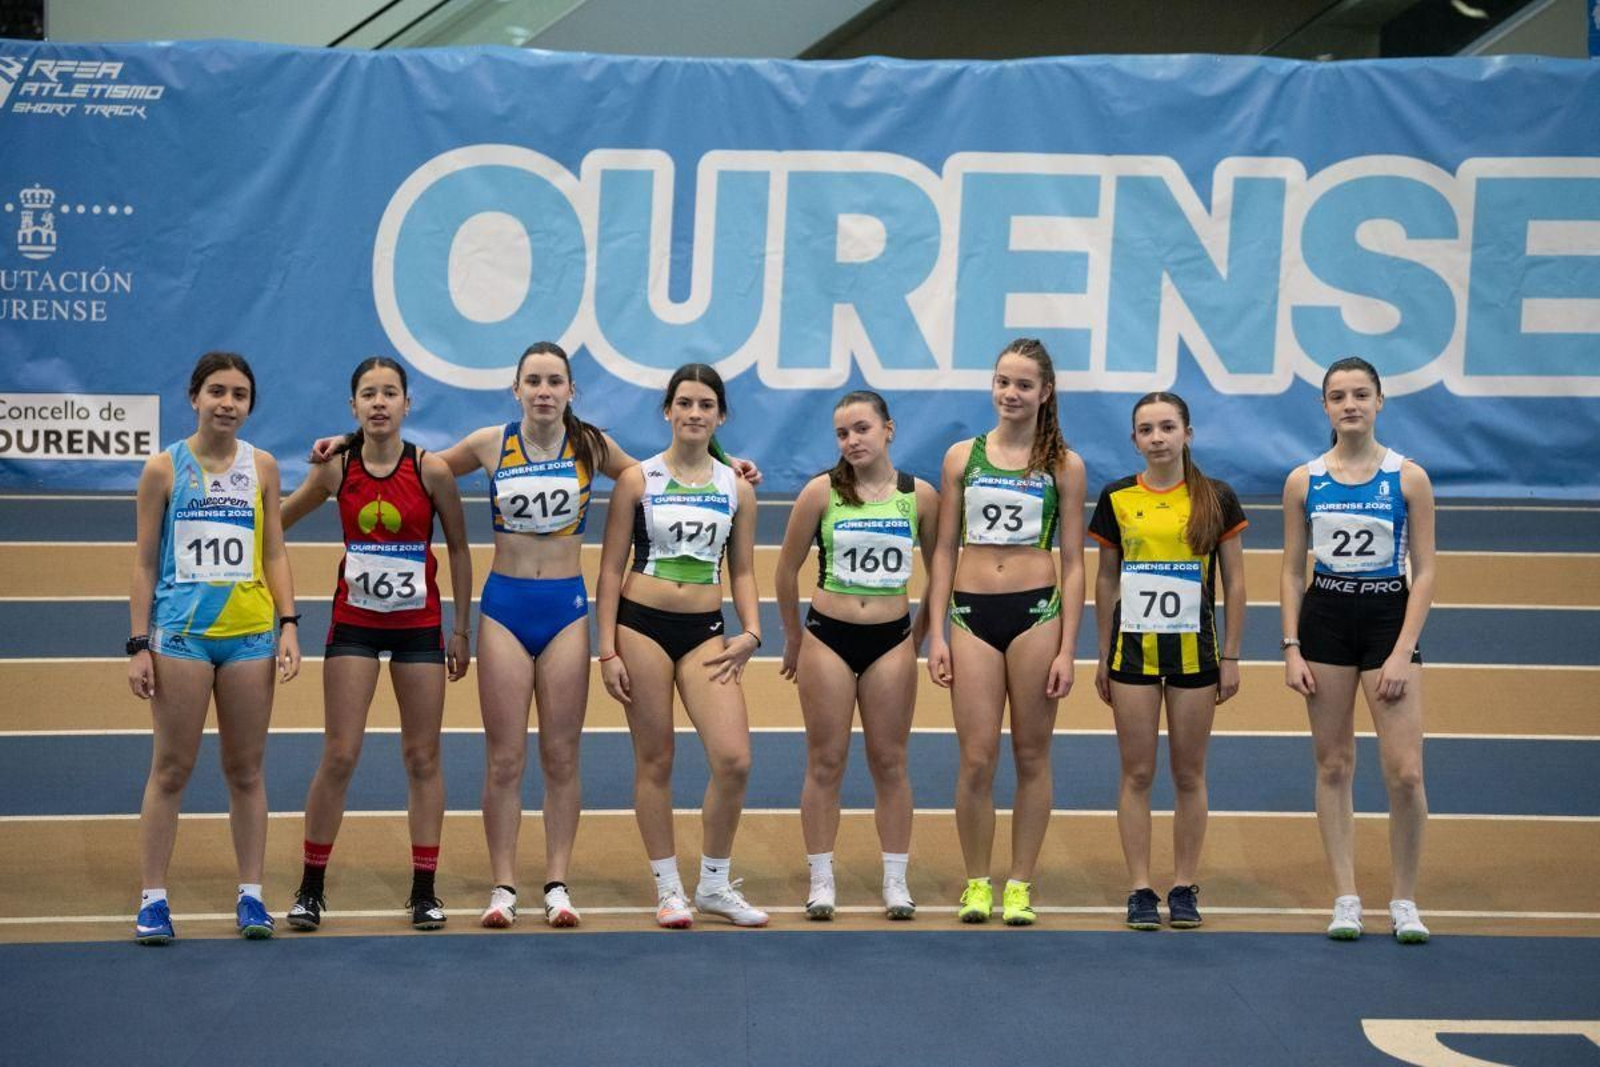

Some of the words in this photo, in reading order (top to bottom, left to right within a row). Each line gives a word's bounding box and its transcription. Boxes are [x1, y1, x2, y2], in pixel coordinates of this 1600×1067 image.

[28, 60, 124, 82] RFEA
[19, 82, 165, 100] ATLETISMO
[12, 102, 76, 117] SHORT
[84, 104, 147, 119] TRACK
[378, 148, 1600, 393] OURENSE
[100, 402, 125, 421] de
[498, 464, 546, 478] OURENSE
[547, 460, 574, 471] 2026
[510, 489, 571, 518] 212
[655, 495, 703, 504] OURENSE
[704, 495, 727, 504] 2026
[1315, 502, 1363, 511] OURENSE
[1364, 502, 1392, 510] 2026
[176, 510, 226, 518] OURENSE
[983, 504, 1023, 532] 93
[669, 521, 717, 546] 171
[885, 520, 909, 528] 2026
[187, 538, 244, 566] 110
[351, 544, 398, 552] OURENSE
[398, 544, 425, 552] 2026
[1332, 530, 1376, 556] 22
[843, 547, 903, 573] 160
[1126, 563, 1171, 571] OURENSE
[1172, 563, 1199, 571] 2026
[355, 572, 416, 599] 163
[1315, 576, 1358, 593] NIKE
[1359, 580, 1402, 594] PRO
[1140, 591, 1181, 618] 70
